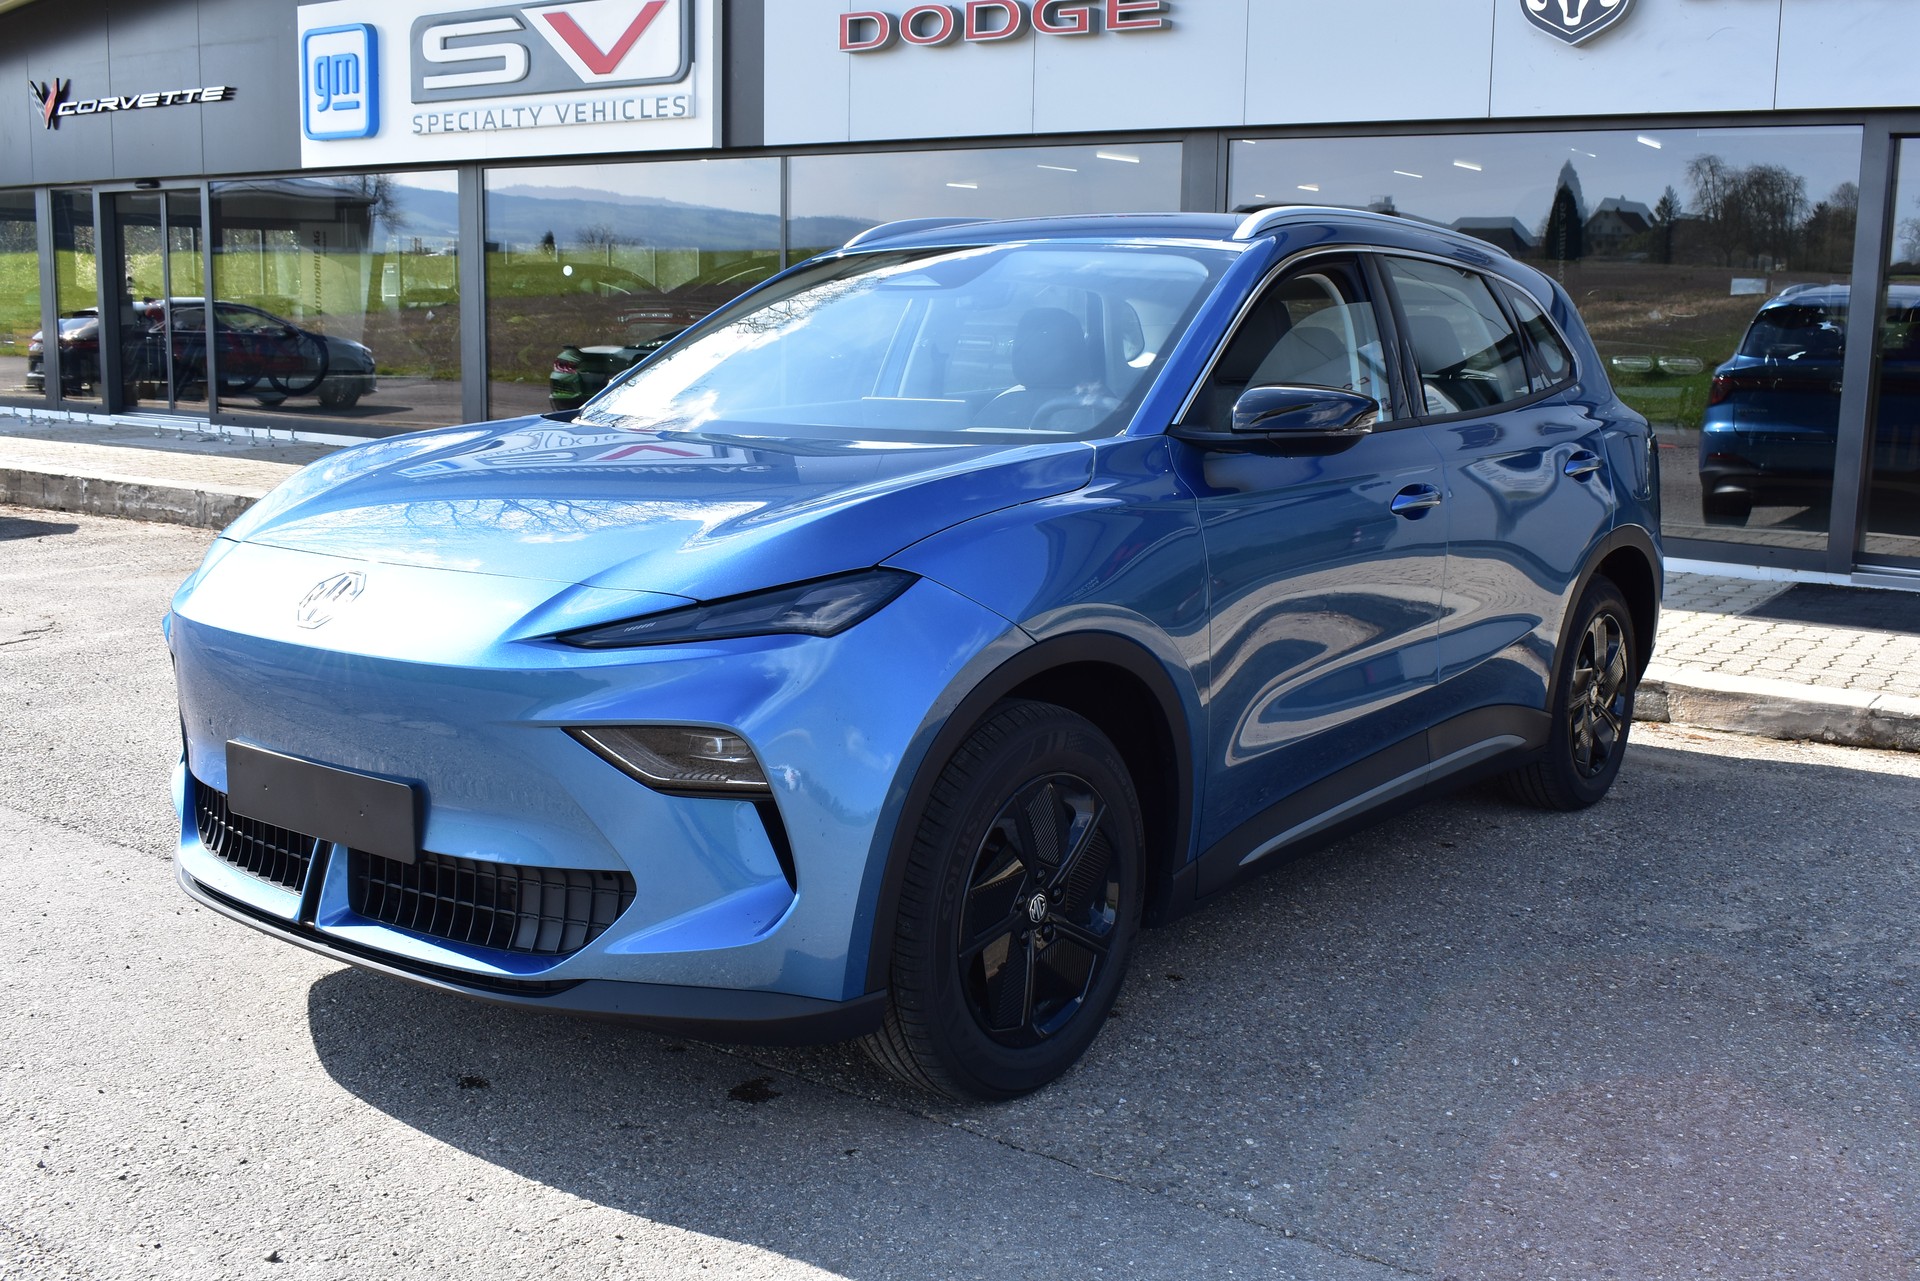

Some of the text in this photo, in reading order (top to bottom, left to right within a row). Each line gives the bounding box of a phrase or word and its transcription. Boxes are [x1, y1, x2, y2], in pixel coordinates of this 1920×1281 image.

[422, 0, 668, 90] SV
[839, 0, 1171, 53] DODGE
[57, 86, 227, 117] CORVETTE
[313, 52, 361, 112] gm
[412, 95, 688, 134] SPECIALTY VEHICLES
[313, 230, 321, 246] AG
[1030, 895, 1046, 922] MG
